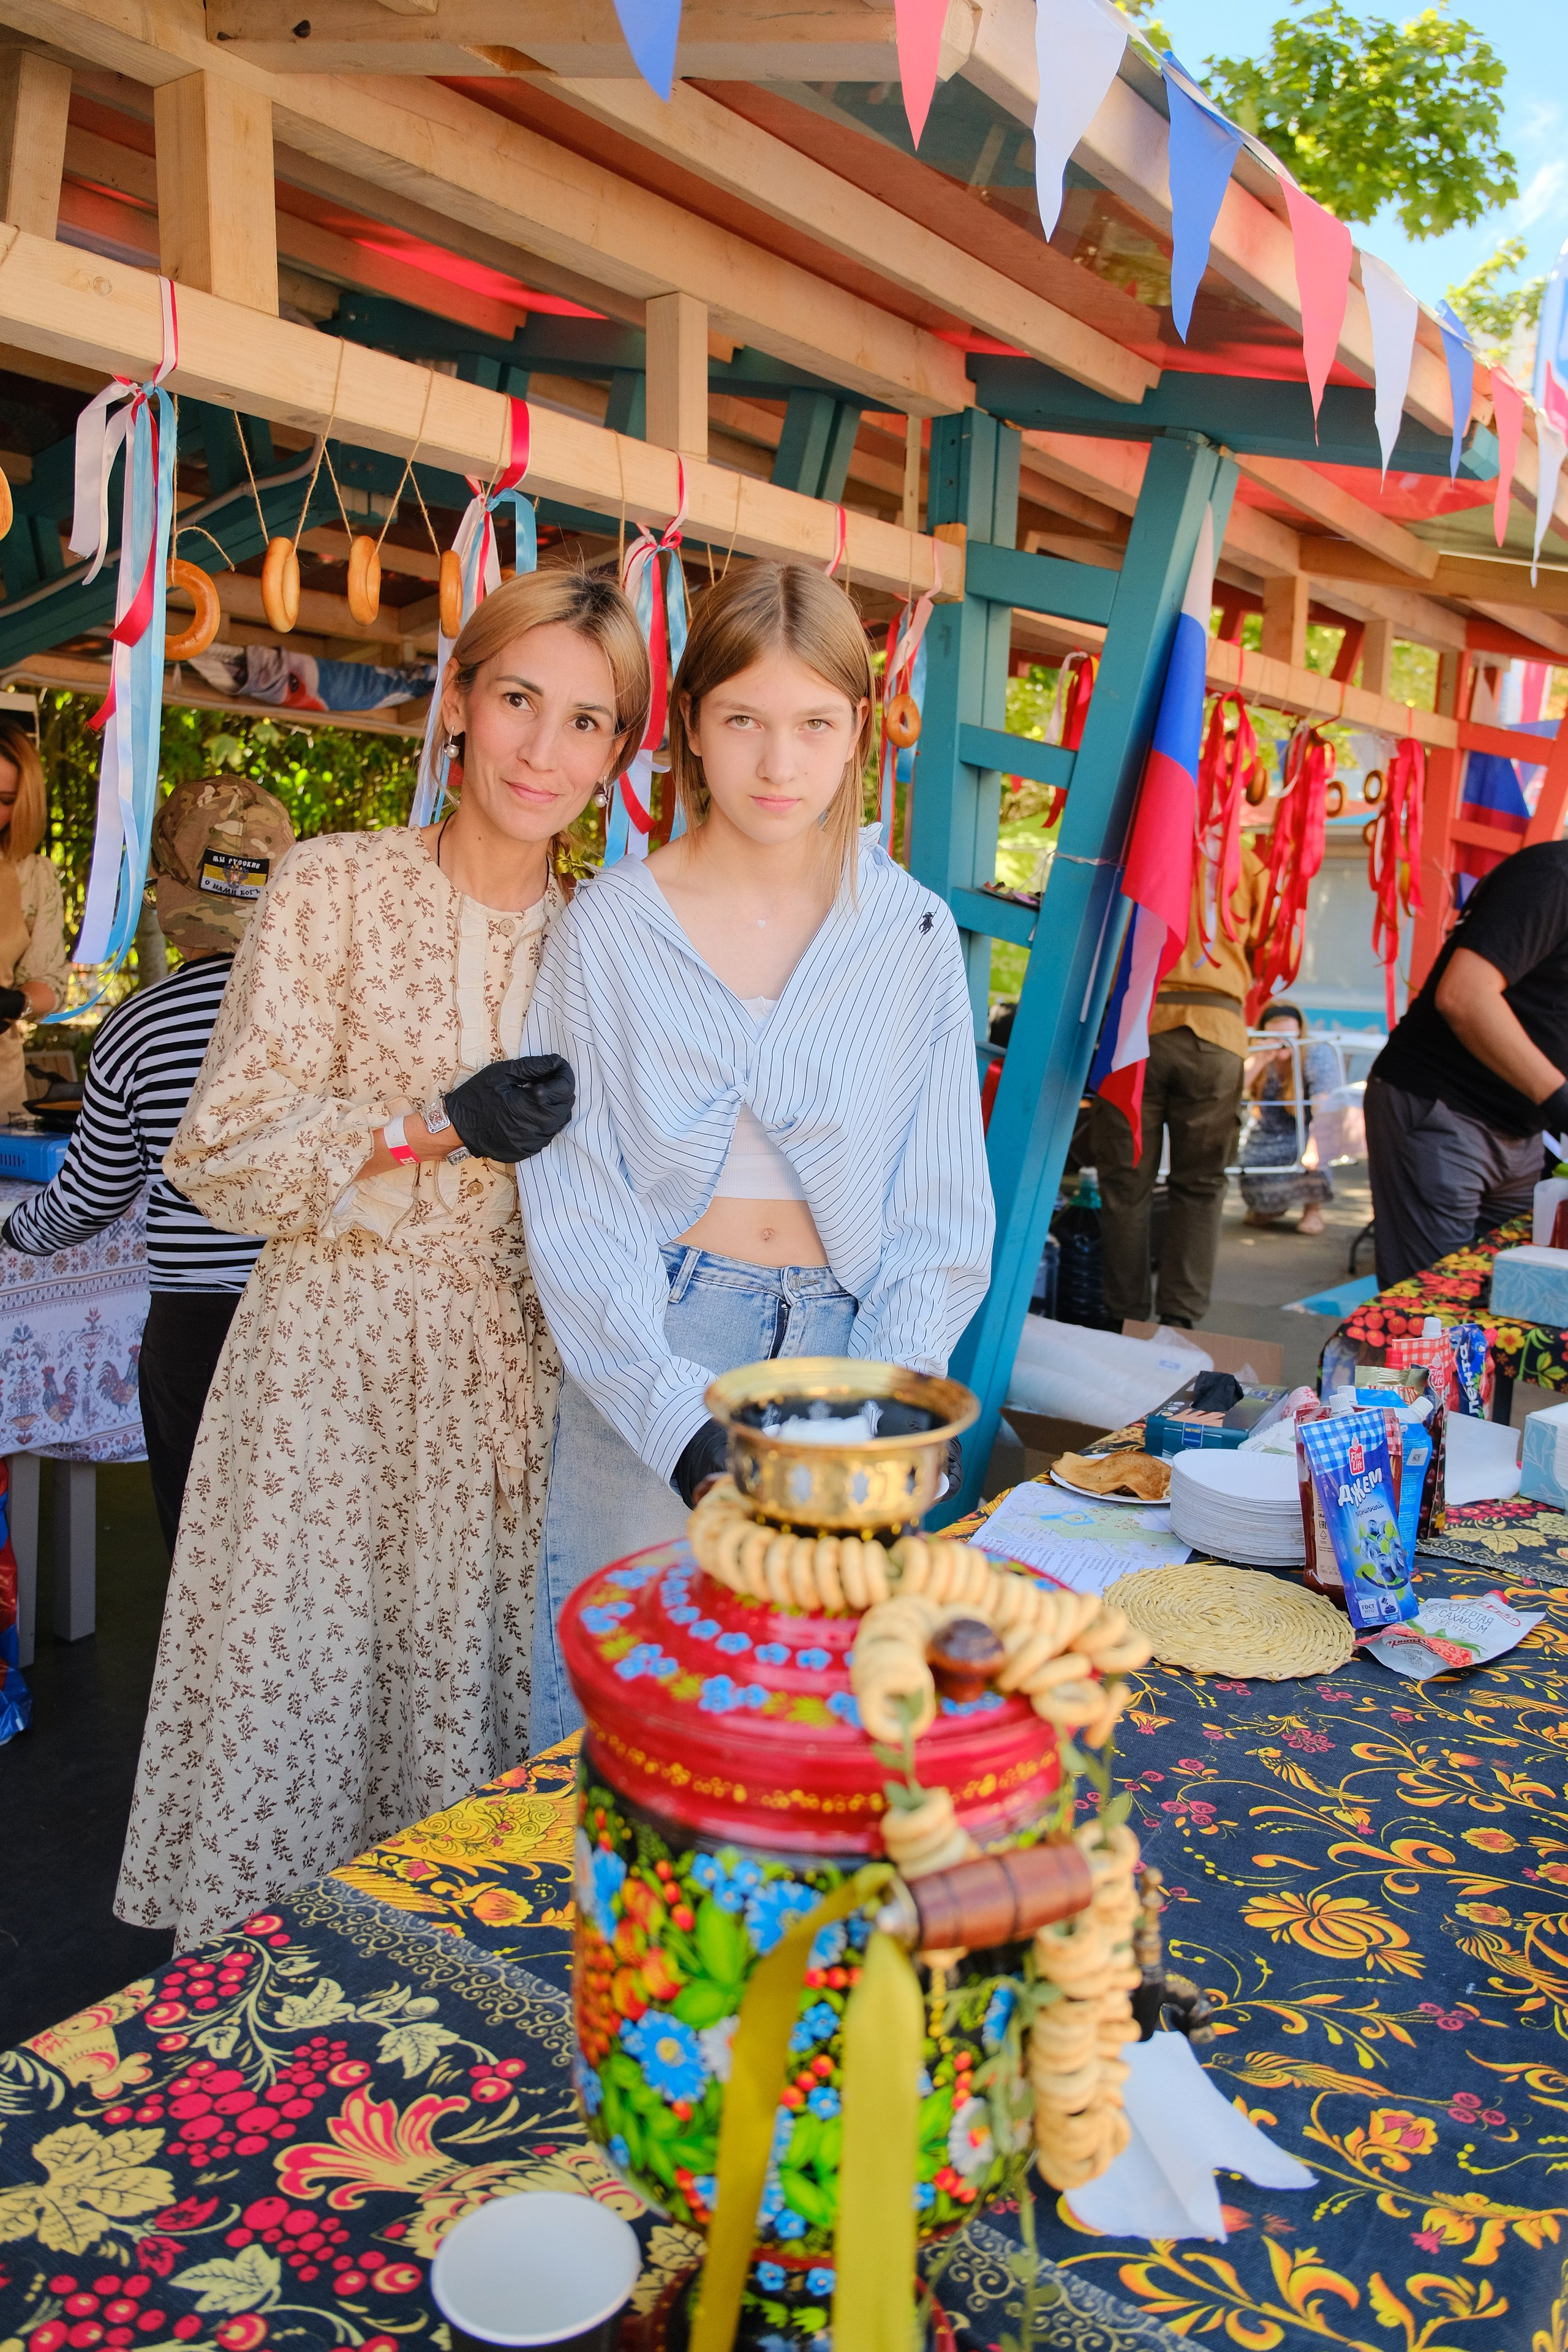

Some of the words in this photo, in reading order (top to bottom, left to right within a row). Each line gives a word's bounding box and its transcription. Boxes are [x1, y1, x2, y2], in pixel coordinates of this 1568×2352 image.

[213, 883, 236, 895] НАМИ
[1351, 1452, 1362, 1463] Fine
[1352, 1461, 1362, 1471] Life
[1338, 1468, 1382, 1508] ДЖЕМ
[1439, 1609, 1488, 1634] САХАРОМ
